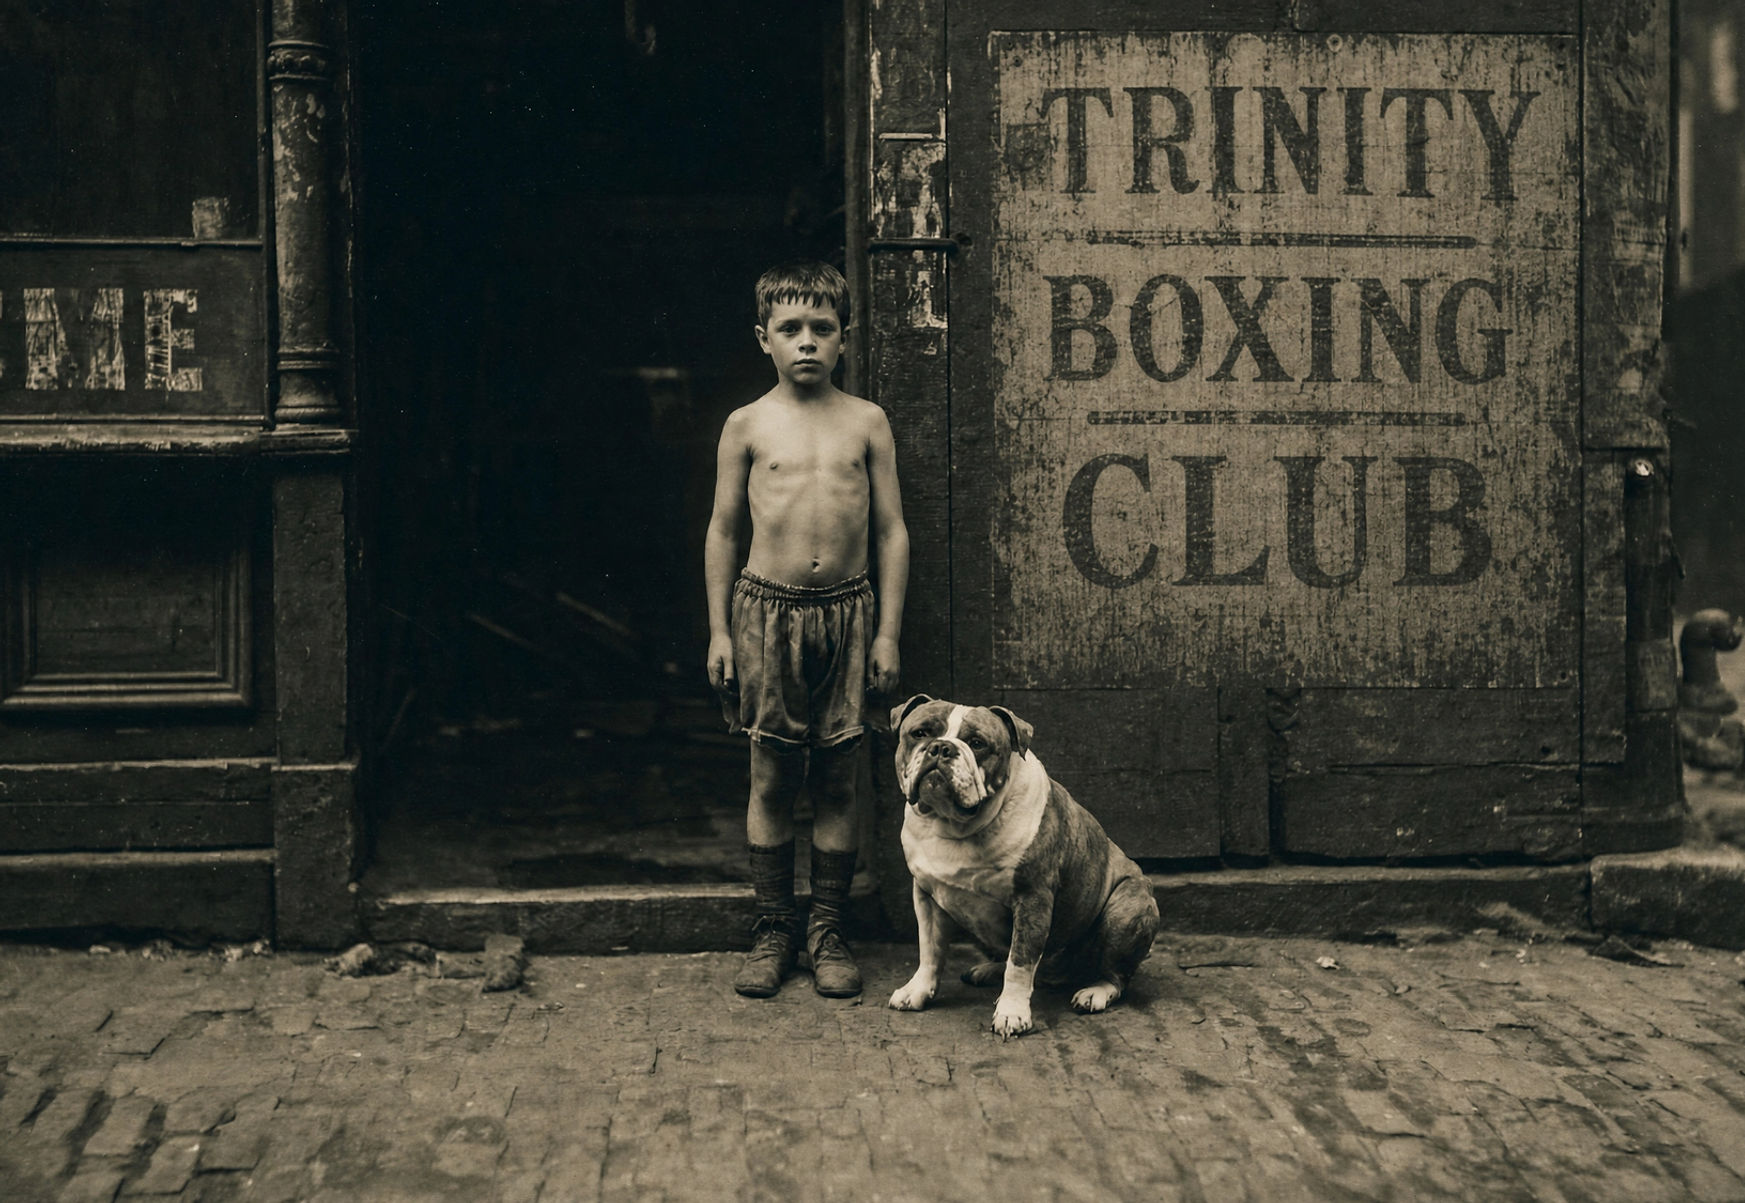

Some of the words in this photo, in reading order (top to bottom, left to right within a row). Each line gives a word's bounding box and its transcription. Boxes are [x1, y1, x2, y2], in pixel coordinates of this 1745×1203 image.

[1041, 86, 1541, 201] TRINITY
[0, 287, 203, 391] ME
[1042, 274, 1514, 386] BOXING
[1063, 453, 1493, 590] CLUB
